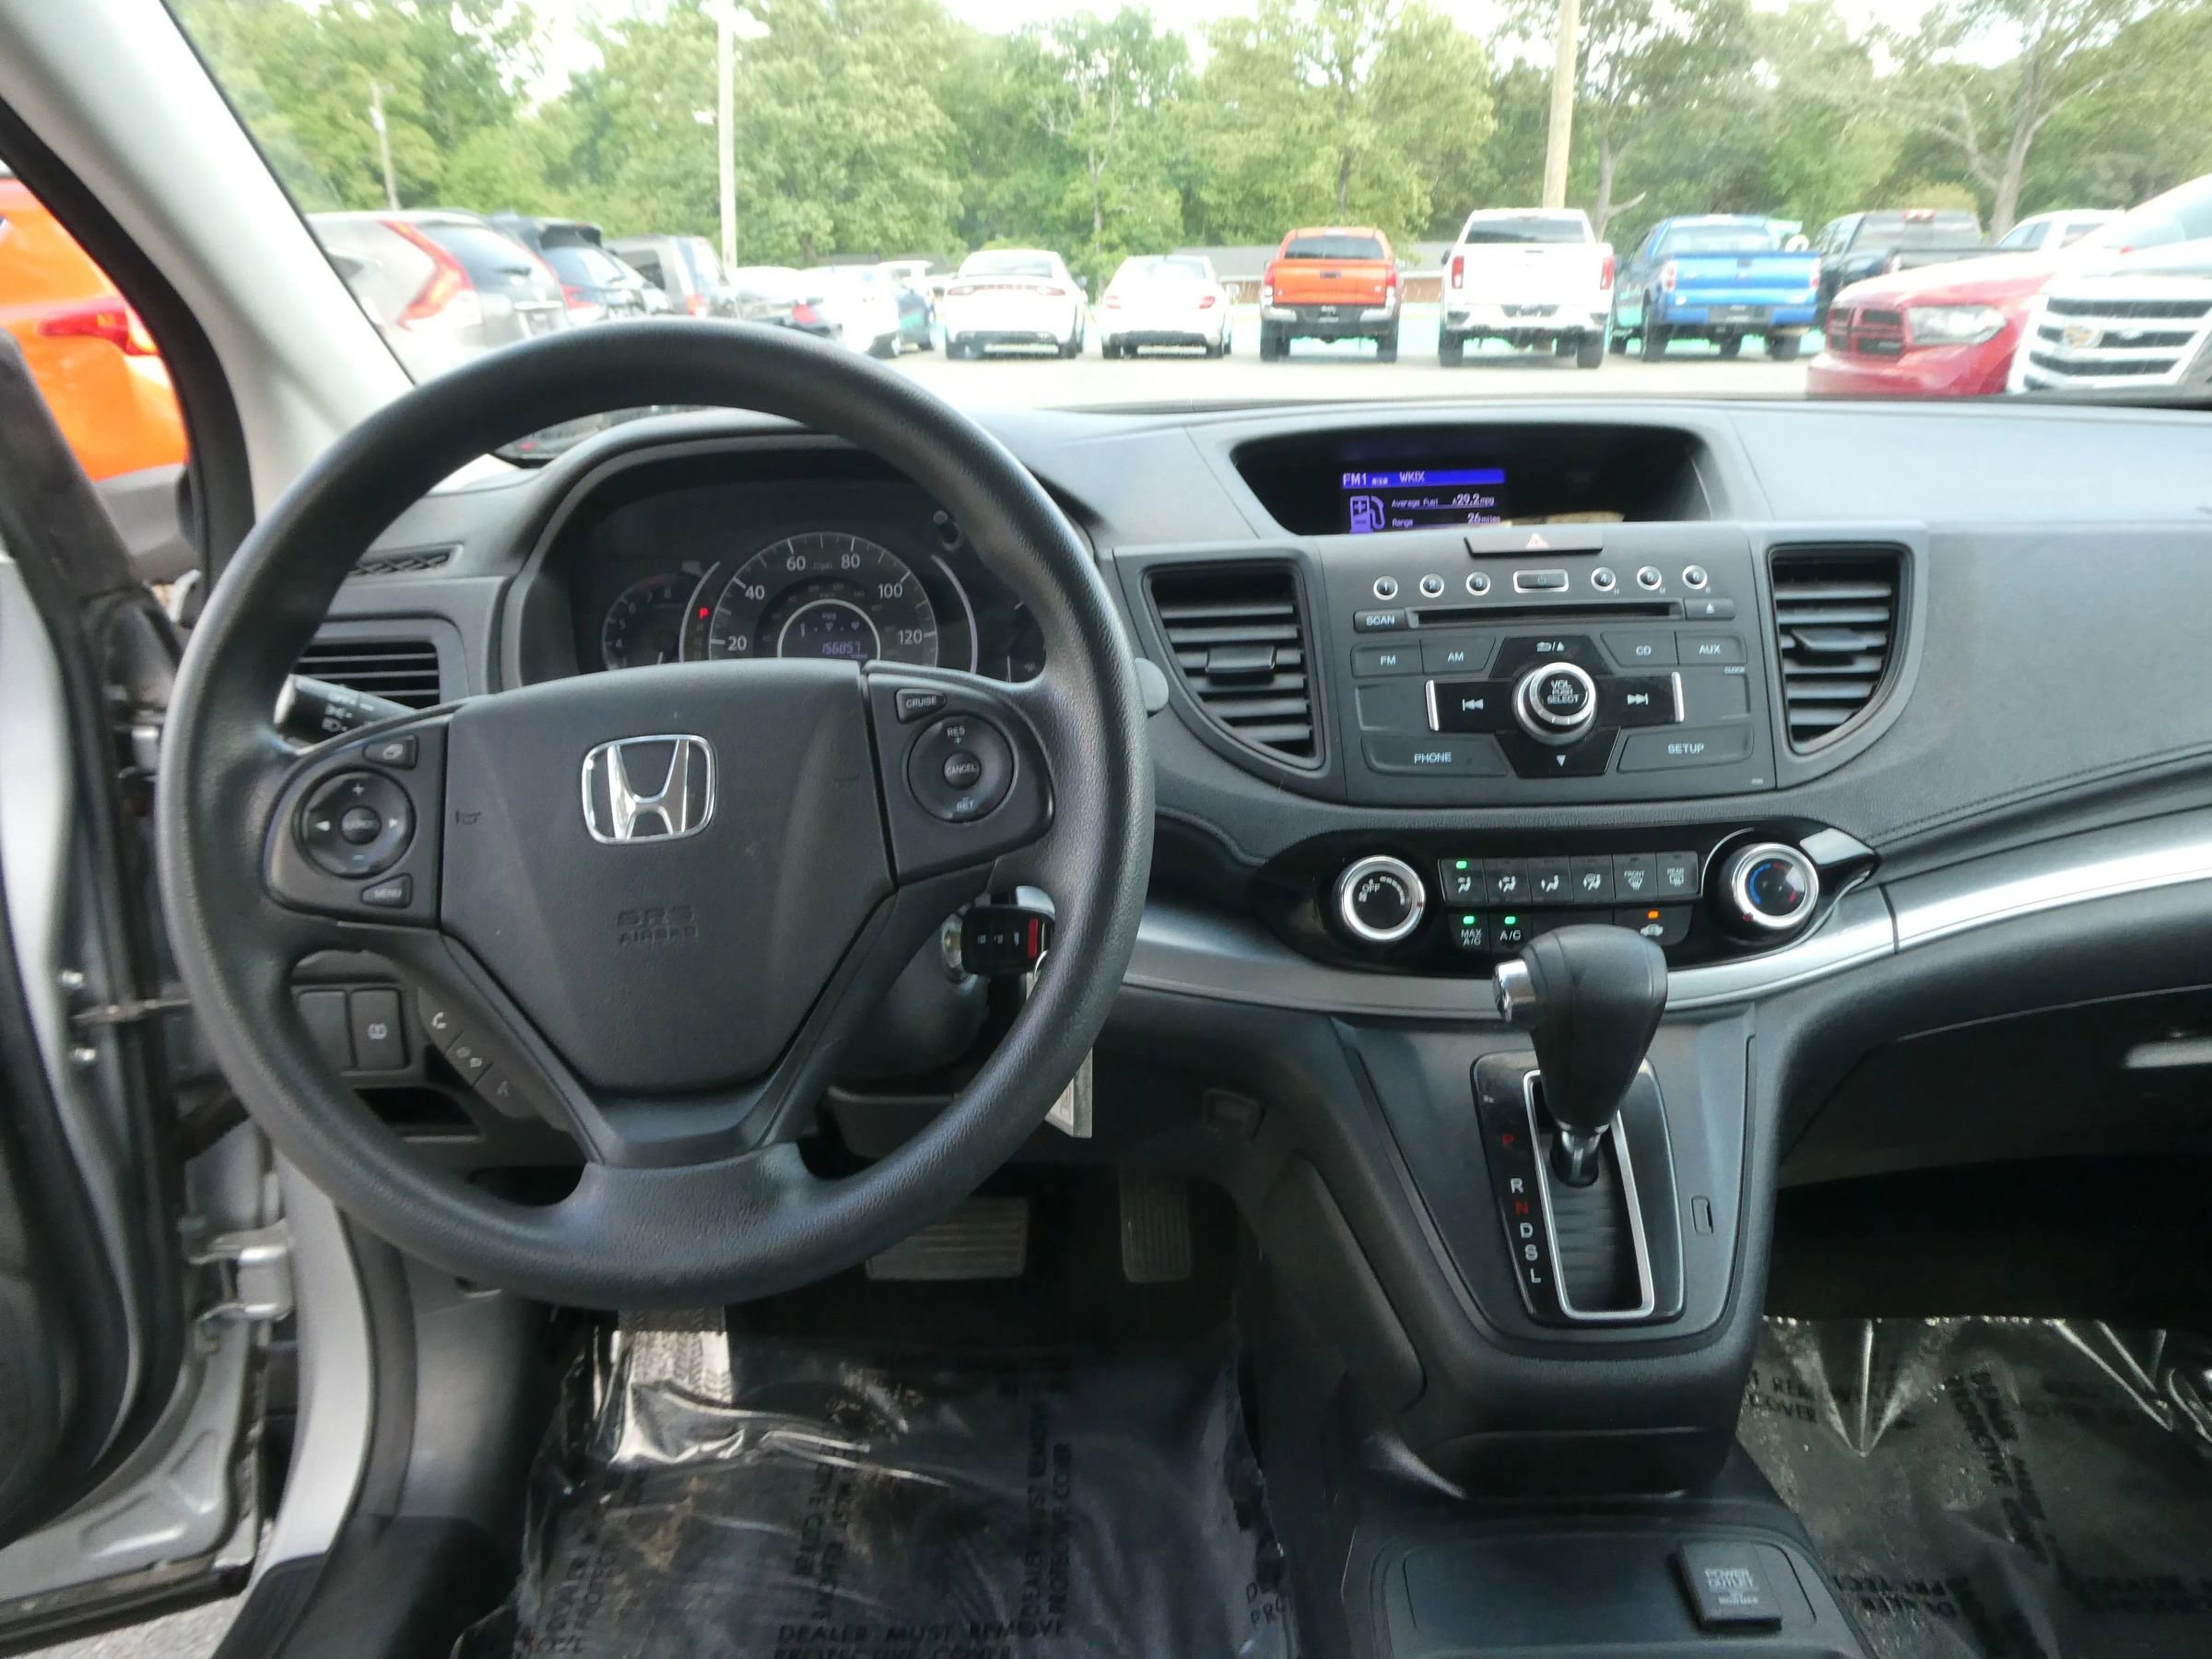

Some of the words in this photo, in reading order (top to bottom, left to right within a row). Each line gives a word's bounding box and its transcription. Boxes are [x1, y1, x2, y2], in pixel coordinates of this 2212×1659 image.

[1342, 472, 1368, 487] FM1
[786, 555, 806, 572] 60
[841, 553, 862, 571] 80
[744, 583, 766, 601] 40
[877, 582, 903, 599] 100
[698, 606, 710, 620] P
[1366, 615, 1395, 627] SCAN
[727, 634, 748, 652] 20
[897, 629, 923, 645] 120
[1447, 651, 1465, 663] AM
[1635, 645, 1652, 657] CD
[1698, 644, 1722, 655] AUX
[1380, 654, 1397, 666] FM
[905, 695, 938, 710] CRUISE
[947, 725, 966, 737] RES
[1667, 742, 1705, 756] SETUP
[1413, 751, 1453, 765] PHONE
[945, 764, 977, 776] CANCEL
[956, 800, 974, 812] SET
[1500, 929, 1522, 942] A/C
[1501, 1134, 1514, 1150] P
[1510, 1177, 1524, 1194] R
[1513, 1200, 1530, 1216] N
[1520, 1221, 1534, 1239] D
[1524, 1243, 1538, 1262] S
[1530, 1268, 1542, 1284] L
[777, 1623, 868, 1643] DEALER
